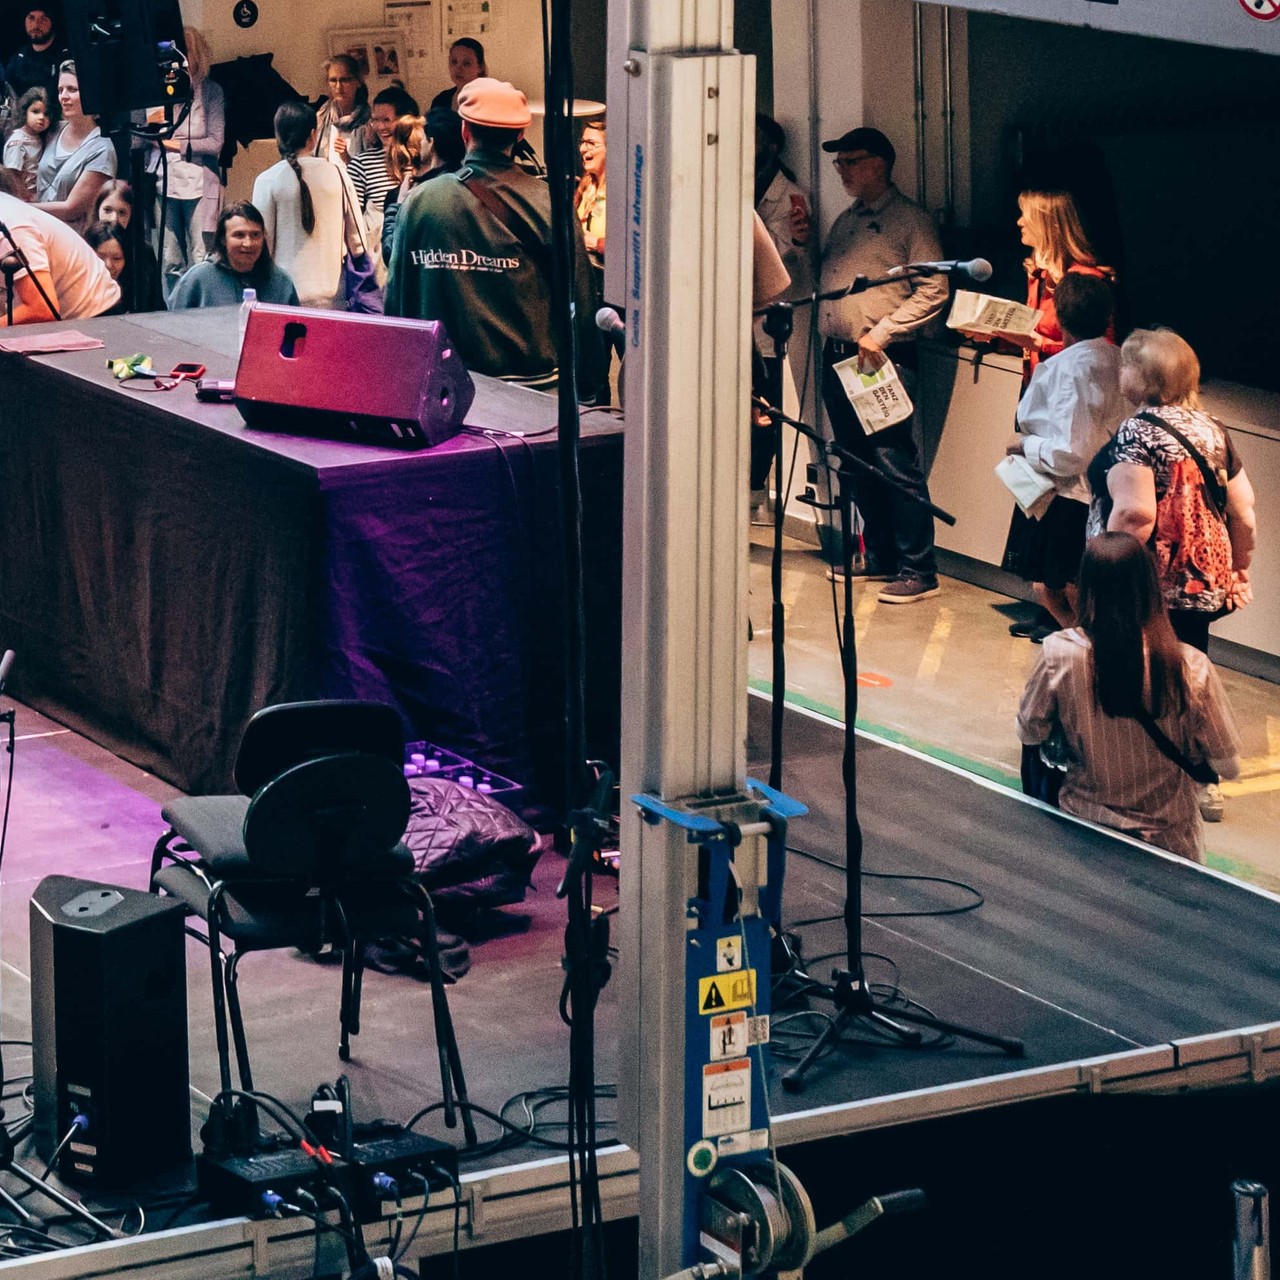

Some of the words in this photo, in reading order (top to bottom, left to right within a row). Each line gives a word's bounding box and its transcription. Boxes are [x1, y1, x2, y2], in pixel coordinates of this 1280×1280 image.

[410, 248, 459, 265] Hidden
[460, 249, 520, 269] Dreams
[878, 386, 890, 401] DEN
[886, 383, 899, 402] TANZ
[872, 389, 891, 418] GASTEIG
